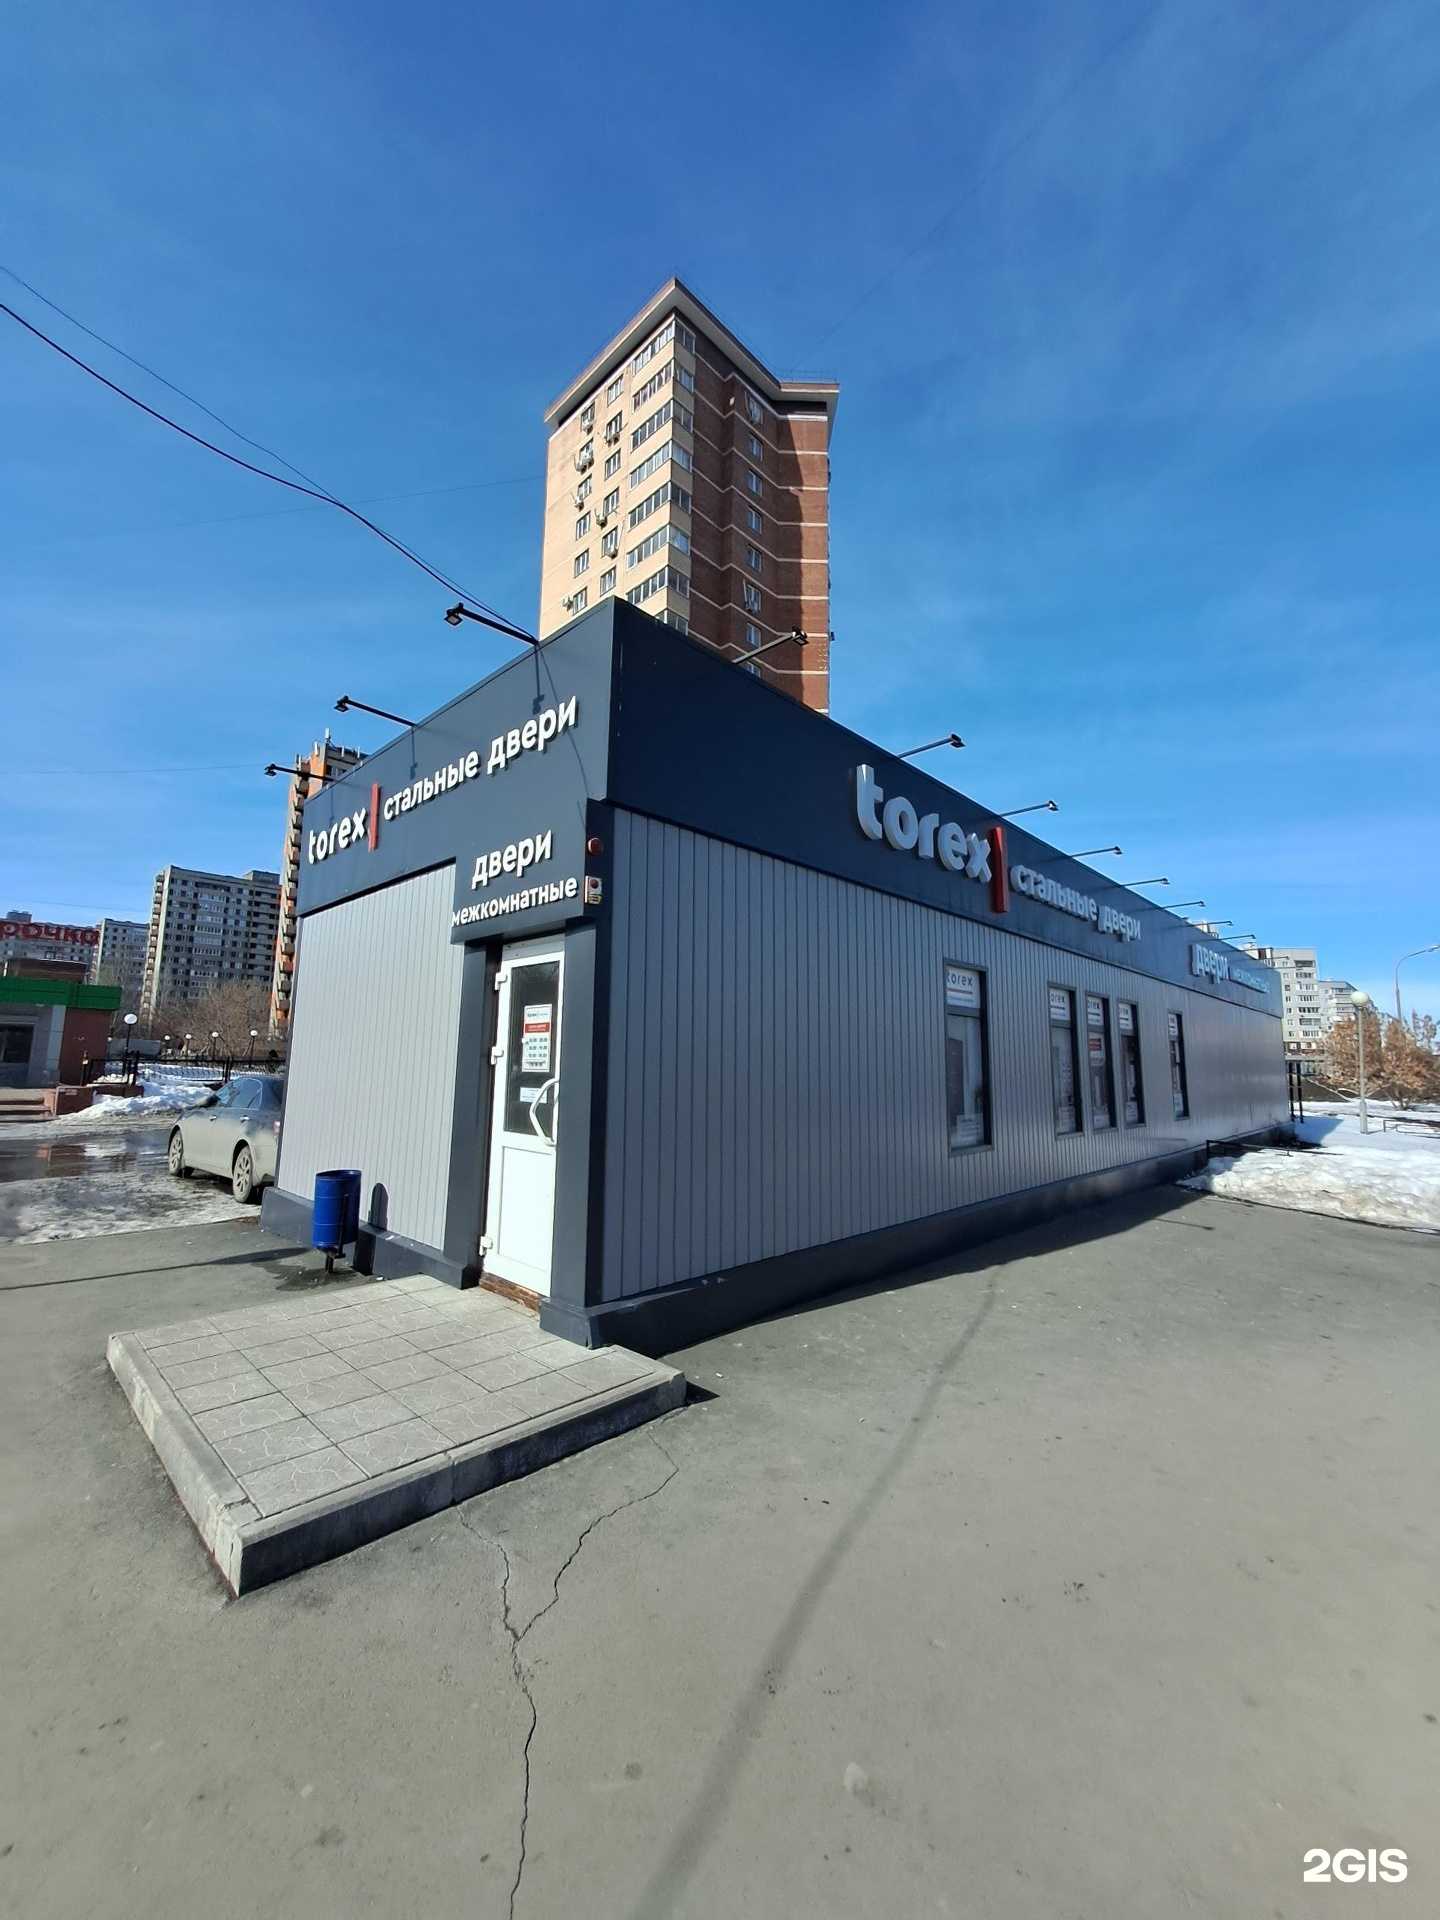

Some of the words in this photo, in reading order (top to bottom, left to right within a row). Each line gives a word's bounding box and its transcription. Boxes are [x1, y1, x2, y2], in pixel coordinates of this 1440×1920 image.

[383, 750, 479, 821] стальные
[487, 696, 577, 775] двери
[309, 806, 367, 865] torex
[855, 763, 993, 884] torex
[471, 830, 552, 889] двери
[451, 877, 578, 927] межкомнатные
[1010, 864, 1097, 921] стальные
[1098, 904, 1141, 943] двери
[1192, 943, 1229, 984] двери
